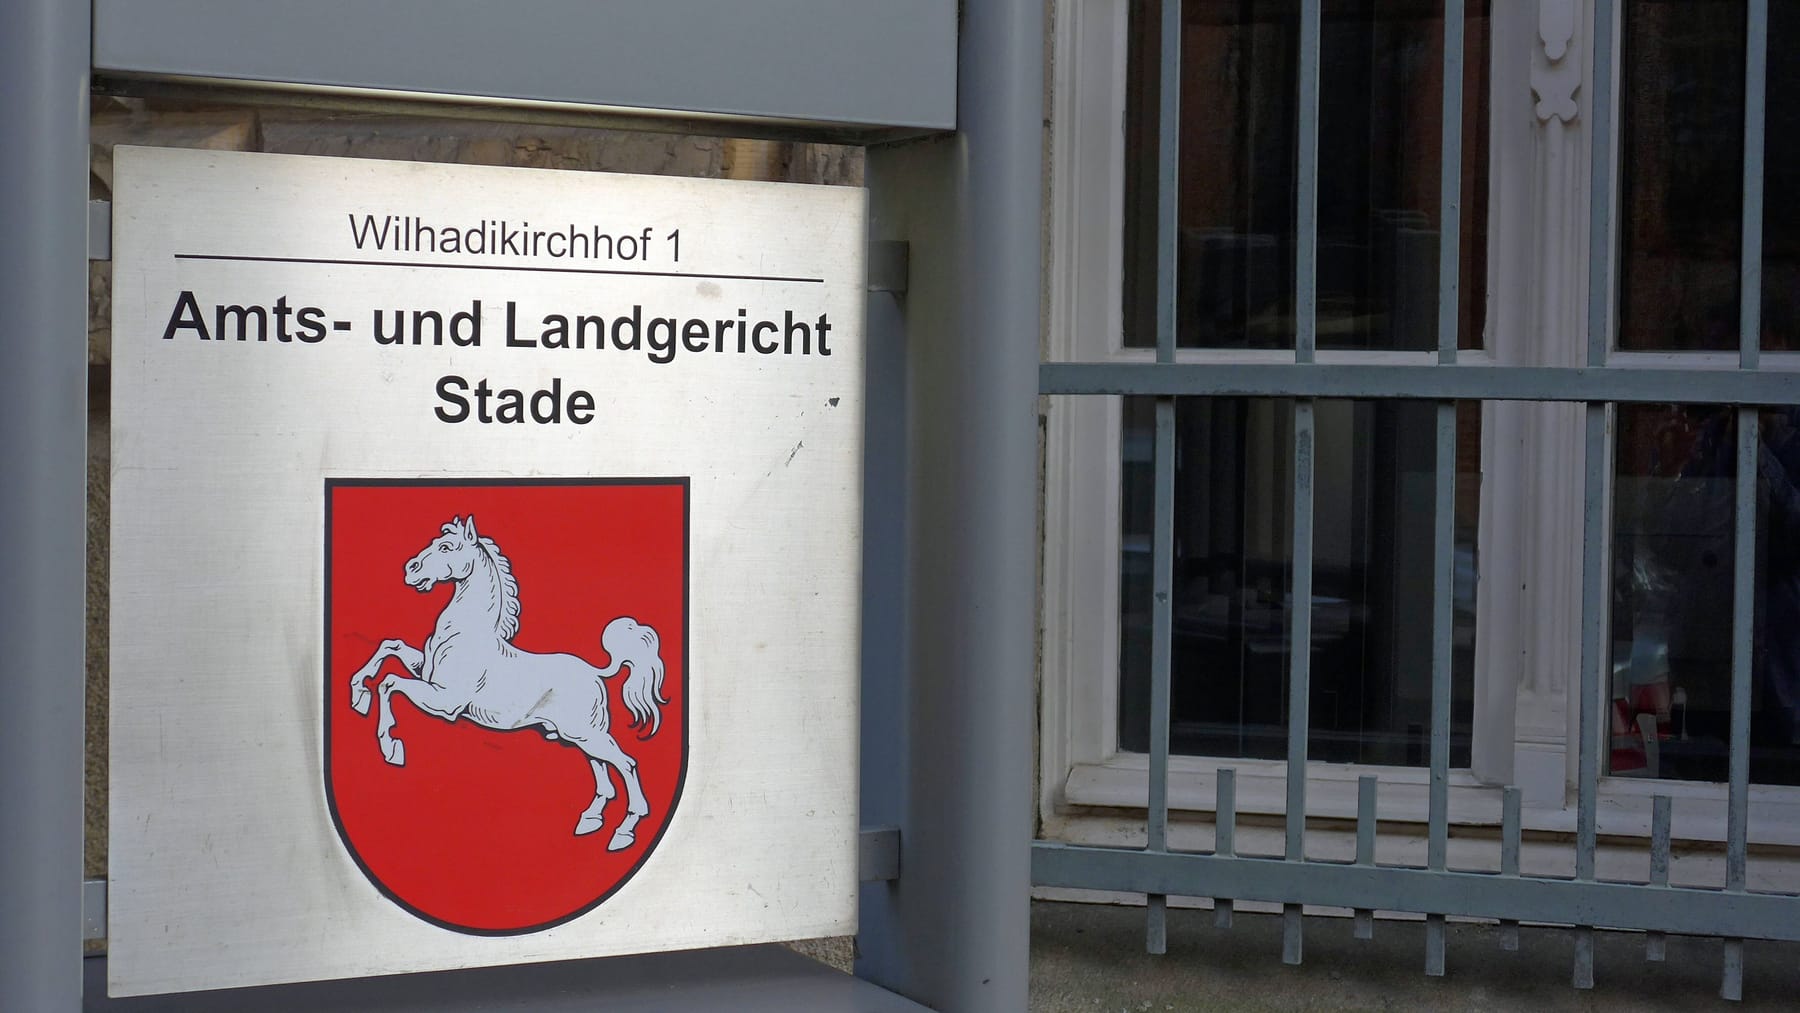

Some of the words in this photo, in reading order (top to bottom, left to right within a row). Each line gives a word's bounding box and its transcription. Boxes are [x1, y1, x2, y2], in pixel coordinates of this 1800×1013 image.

[349, 214, 653, 261] Wilhadikirchhof
[667, 229, 680, 262] 1
[163, 290, 351, 344] Amts-
[373, 299, 482, 347] und
[506, 301, 832, 364] Landgericht
[434, 375, 595, 425] Stade
